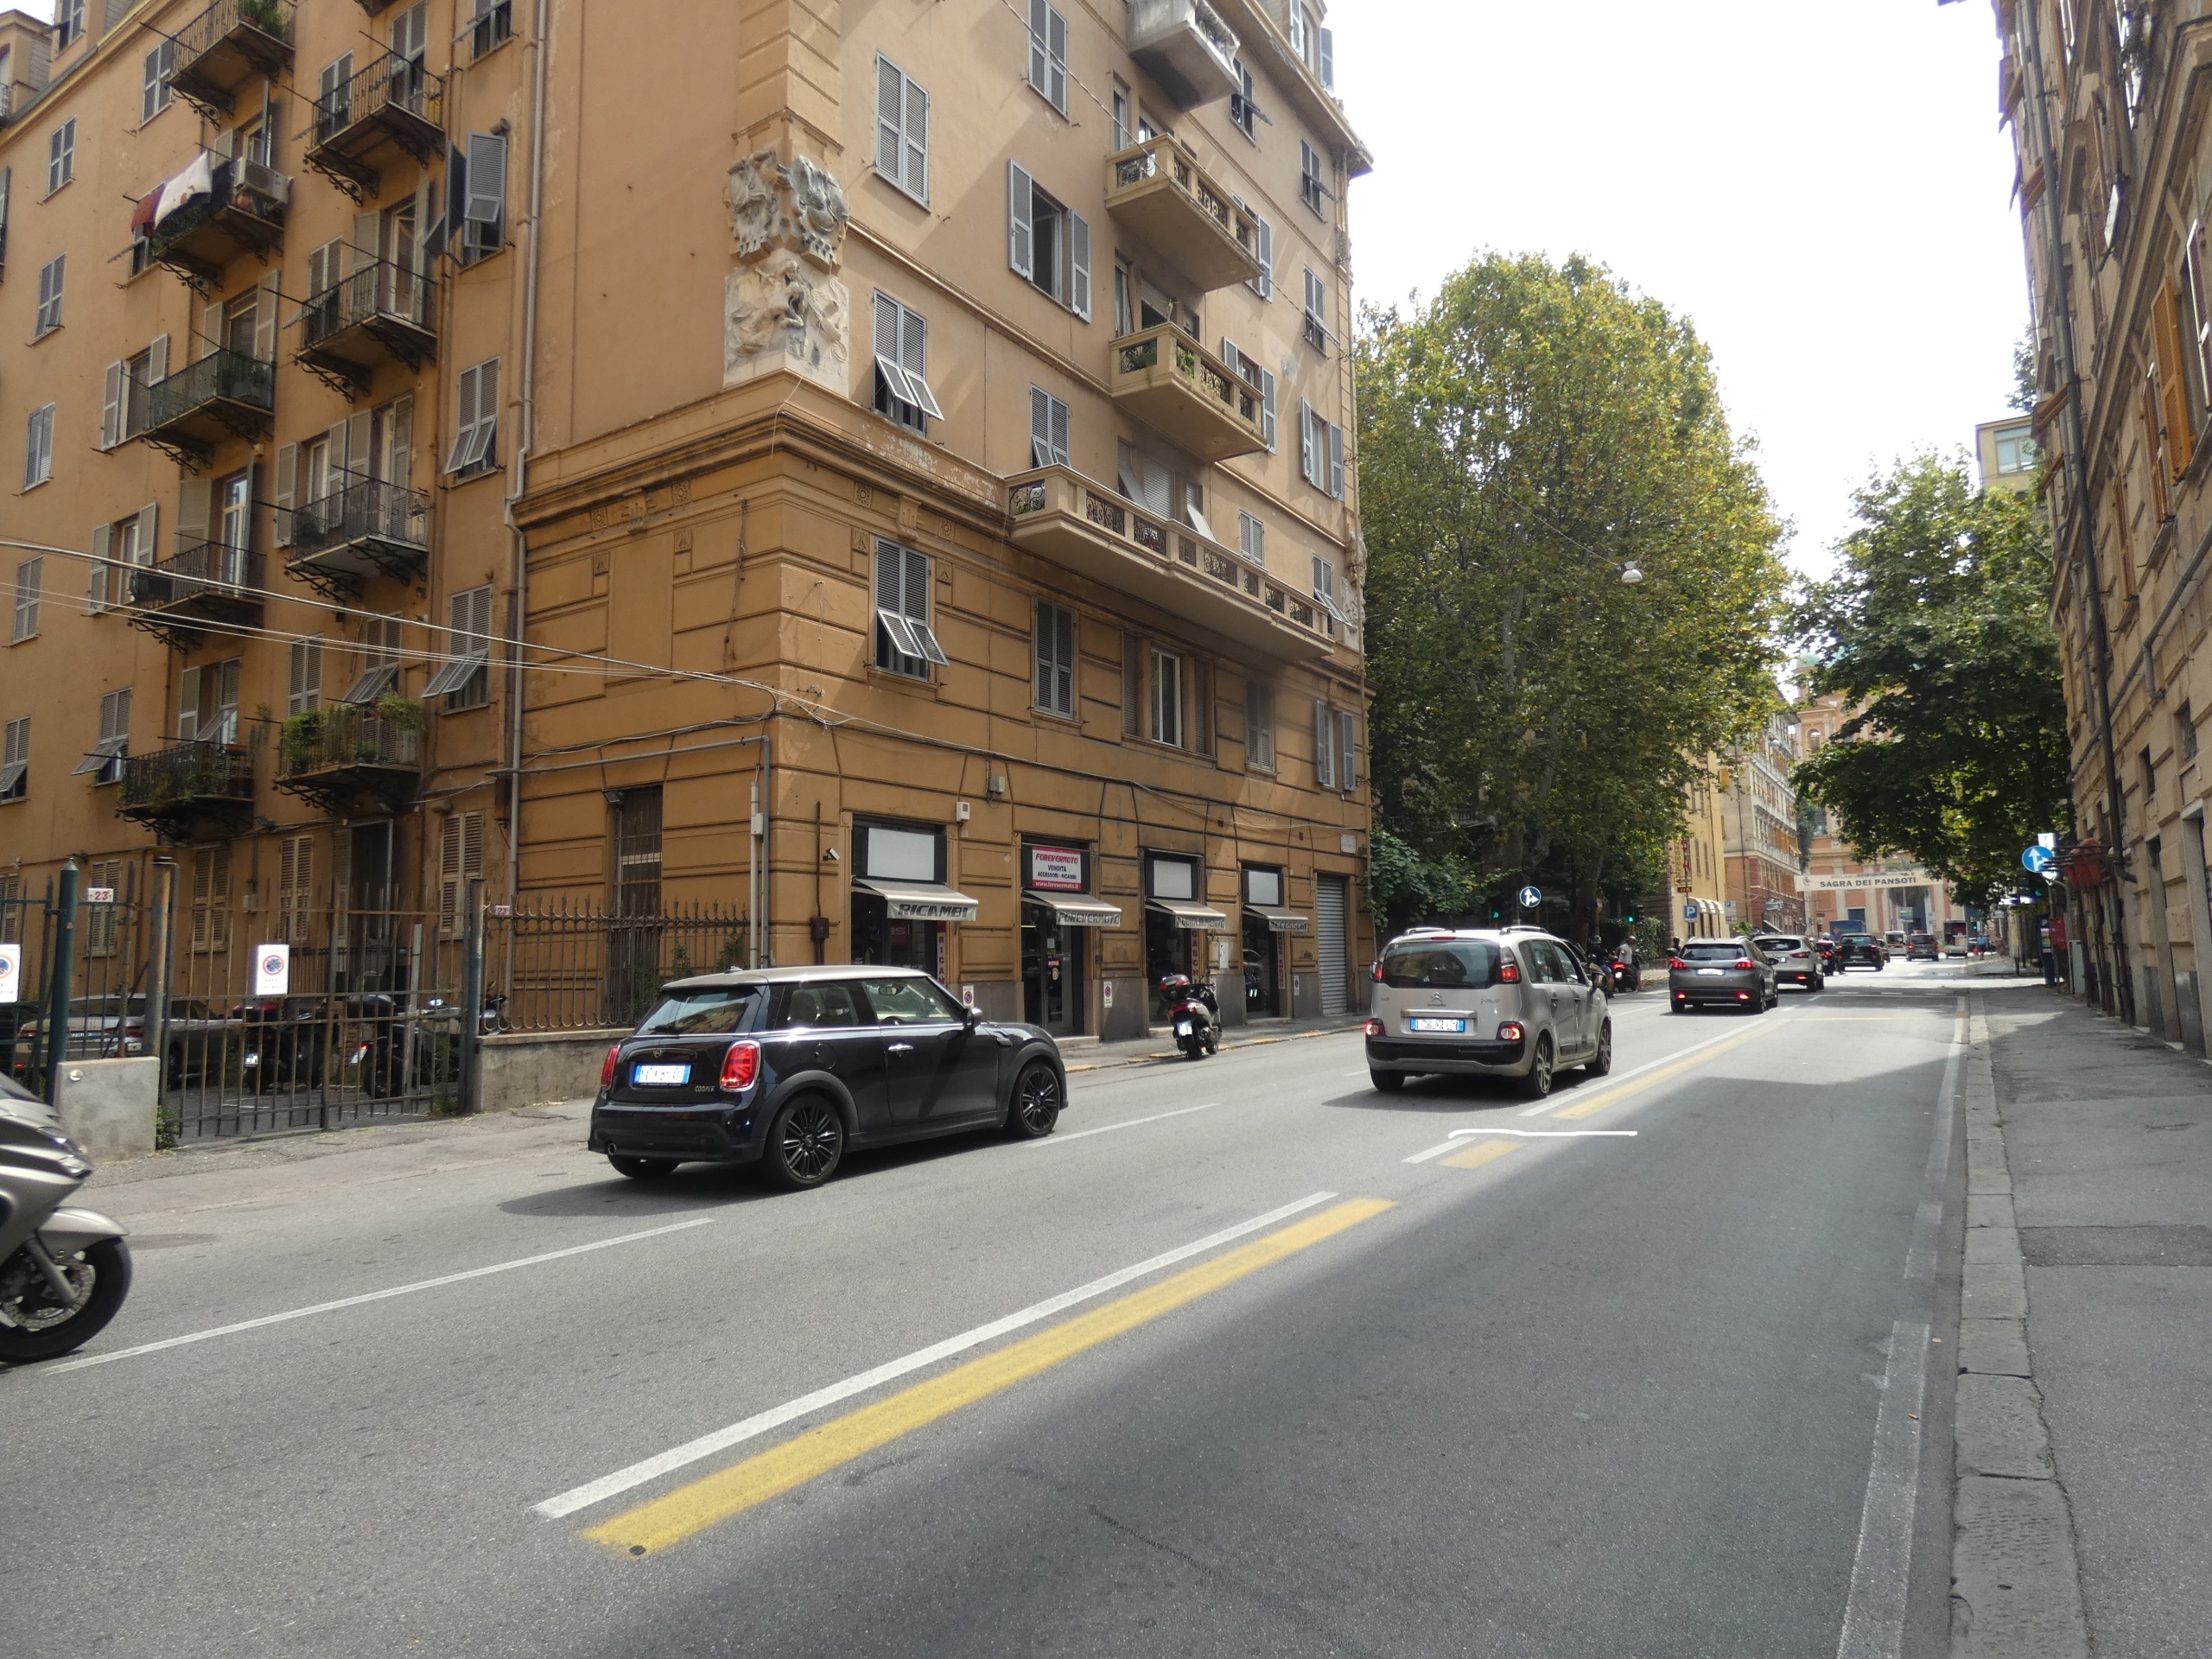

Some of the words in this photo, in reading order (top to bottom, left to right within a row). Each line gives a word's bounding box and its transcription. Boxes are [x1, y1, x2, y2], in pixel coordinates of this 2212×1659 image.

[1035, 853, 1078, 864] FOREVERMOTO
[1035, 880, 1078, 889] www.forevermoto.it
[898, 903, 969, 918] RICAMBI
[1058, 912, 1120, 925] FOREVERMOTO
